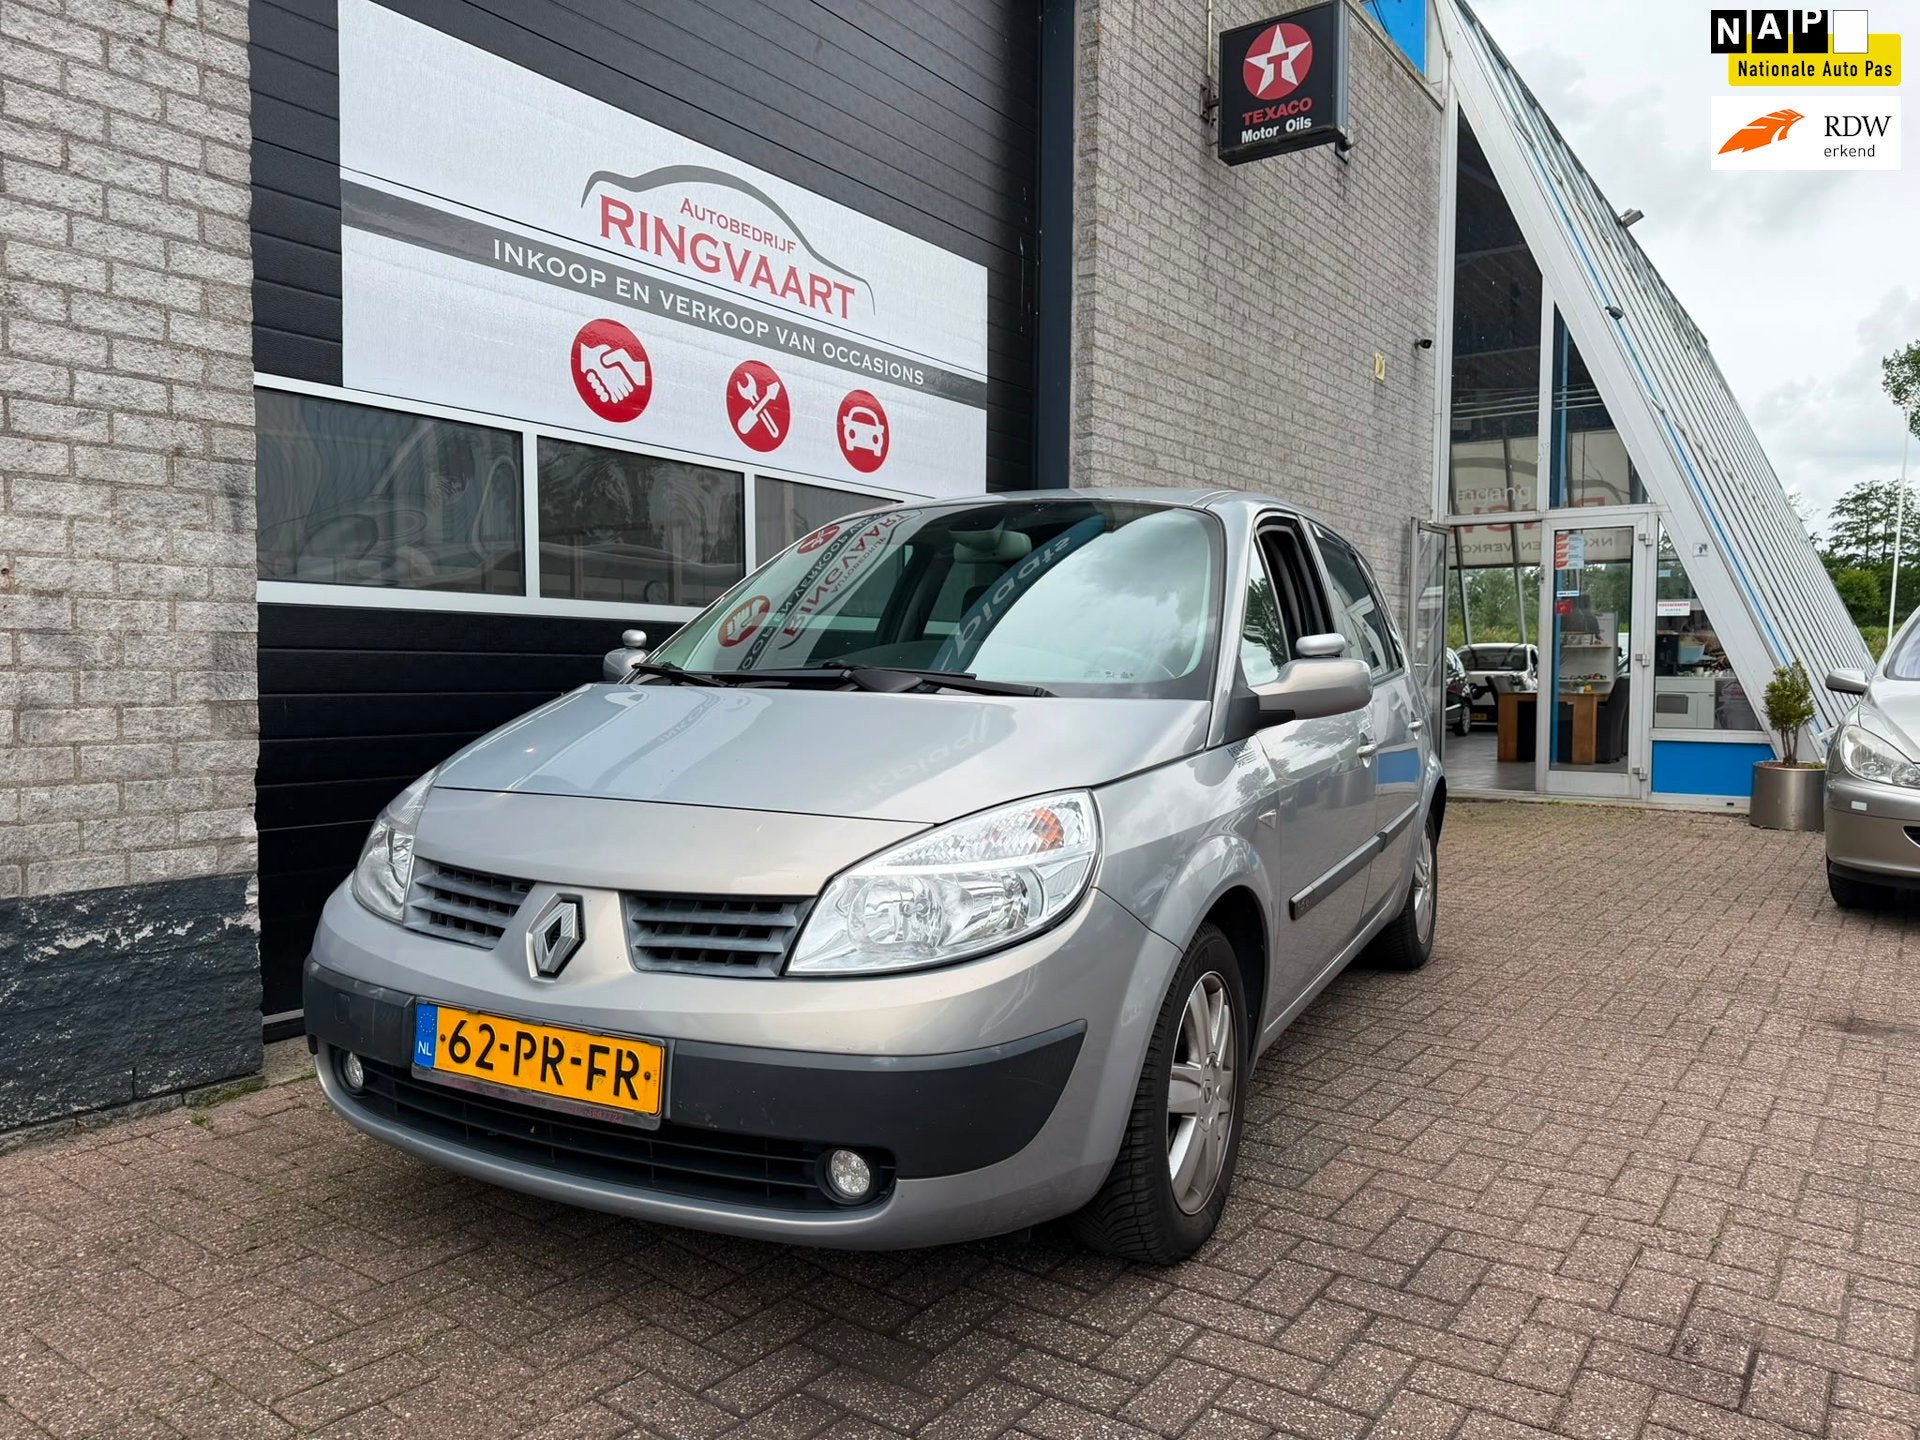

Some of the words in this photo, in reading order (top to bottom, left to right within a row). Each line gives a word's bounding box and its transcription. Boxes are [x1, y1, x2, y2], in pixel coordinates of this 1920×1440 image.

[1241, 125, 1280, 144] Motor
[1285, 116, 1312, 132] Oils
[1242, 97, 1313, 126] TEXACO
[600, 194, 856, 320] RINGVAART
[493, 238, 607, 289] INKOOP
[616, 276, 650, 304] EN
[659, 289, 770, 338] VERKOOP
[775, 324, 817, 354] VAN
[822, 341, 925, 386] OCCASIONS
[417, 1040, 432, 1057] NL
[447, 1019, 639, 1101] 62-PR-FR
